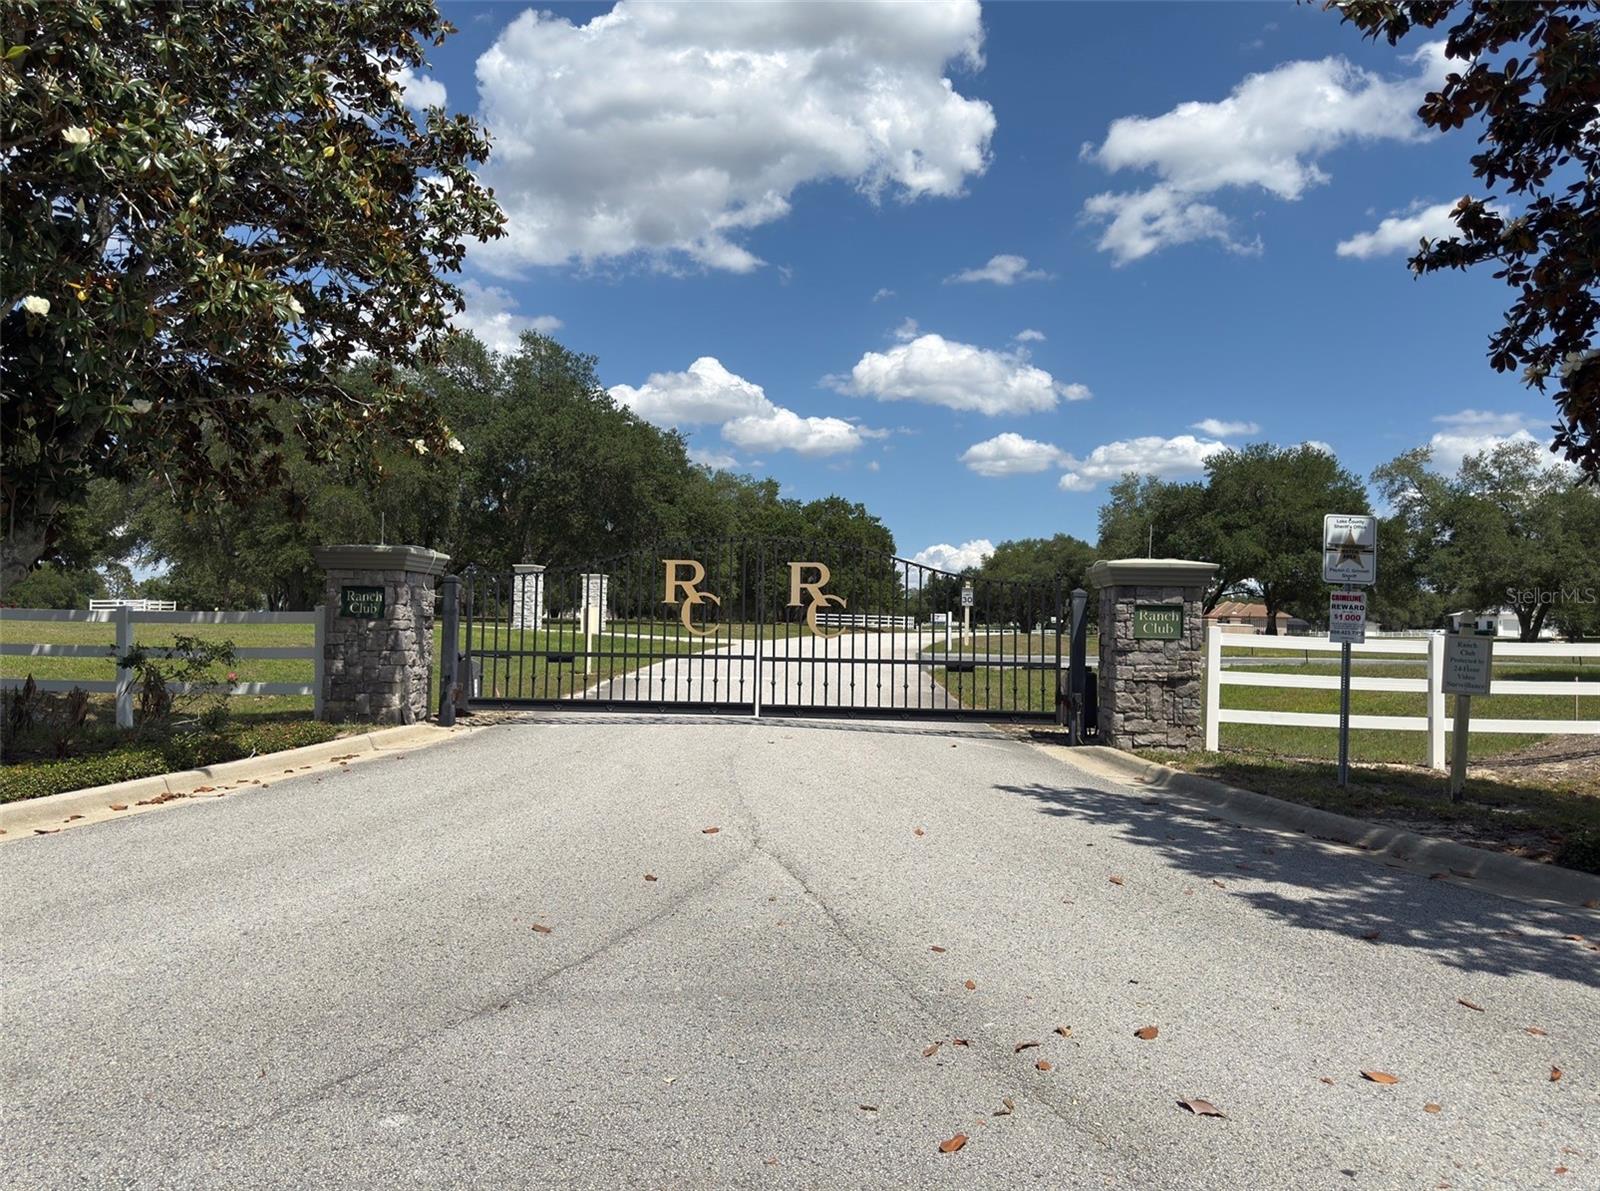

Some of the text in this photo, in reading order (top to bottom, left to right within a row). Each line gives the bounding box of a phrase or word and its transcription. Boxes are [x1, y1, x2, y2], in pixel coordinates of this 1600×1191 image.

[347, 590, 383, 602] Ranch
[350, 602, 378, 614] Club
[1331, 603, 1365, 611] REWARD
[1139, 610, 1179, 621] Ranch
[1142, 622, 1174, 634] Club
